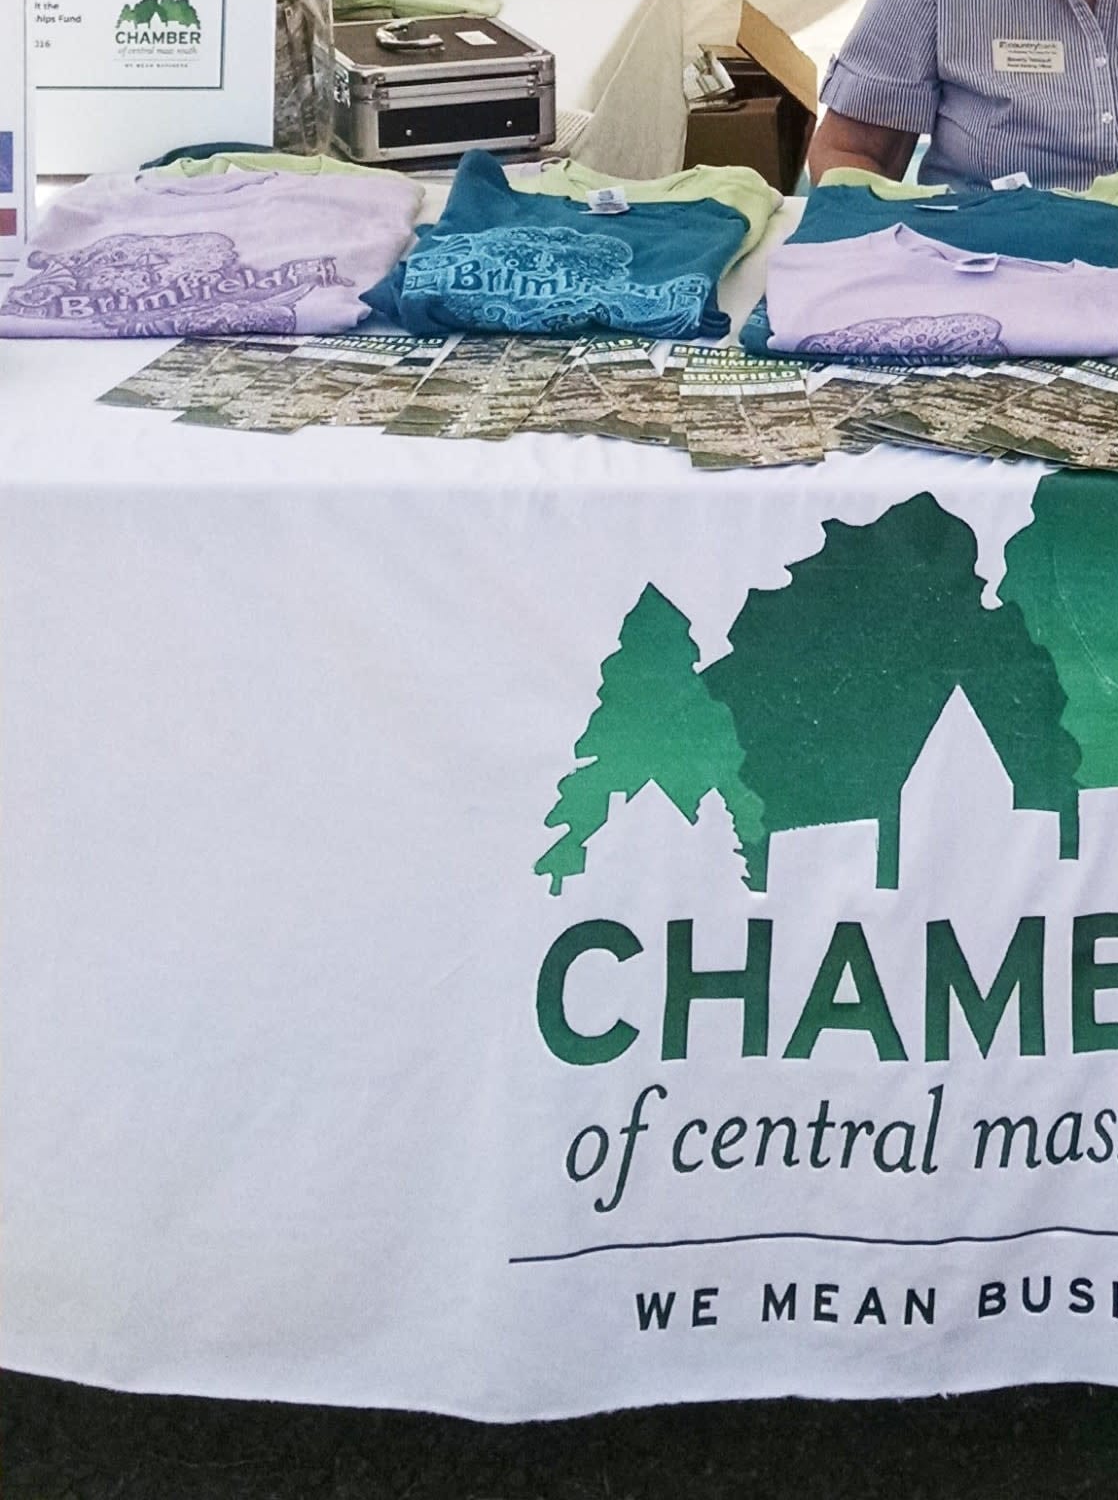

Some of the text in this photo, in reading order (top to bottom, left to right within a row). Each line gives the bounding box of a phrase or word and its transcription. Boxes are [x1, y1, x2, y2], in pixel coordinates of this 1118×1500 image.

[115, 31, 201, 45] CHAMBER
[59, 266, 283, 319] Brimfield
[682, 370, 797, 381] BRIMFIELD
[565, 1083, 668, 1214] of
[671, 1084, 946, 1177] central
[635, 1288, 721, 1334] WE
[760, 1283, 938, 1327] MEAN
